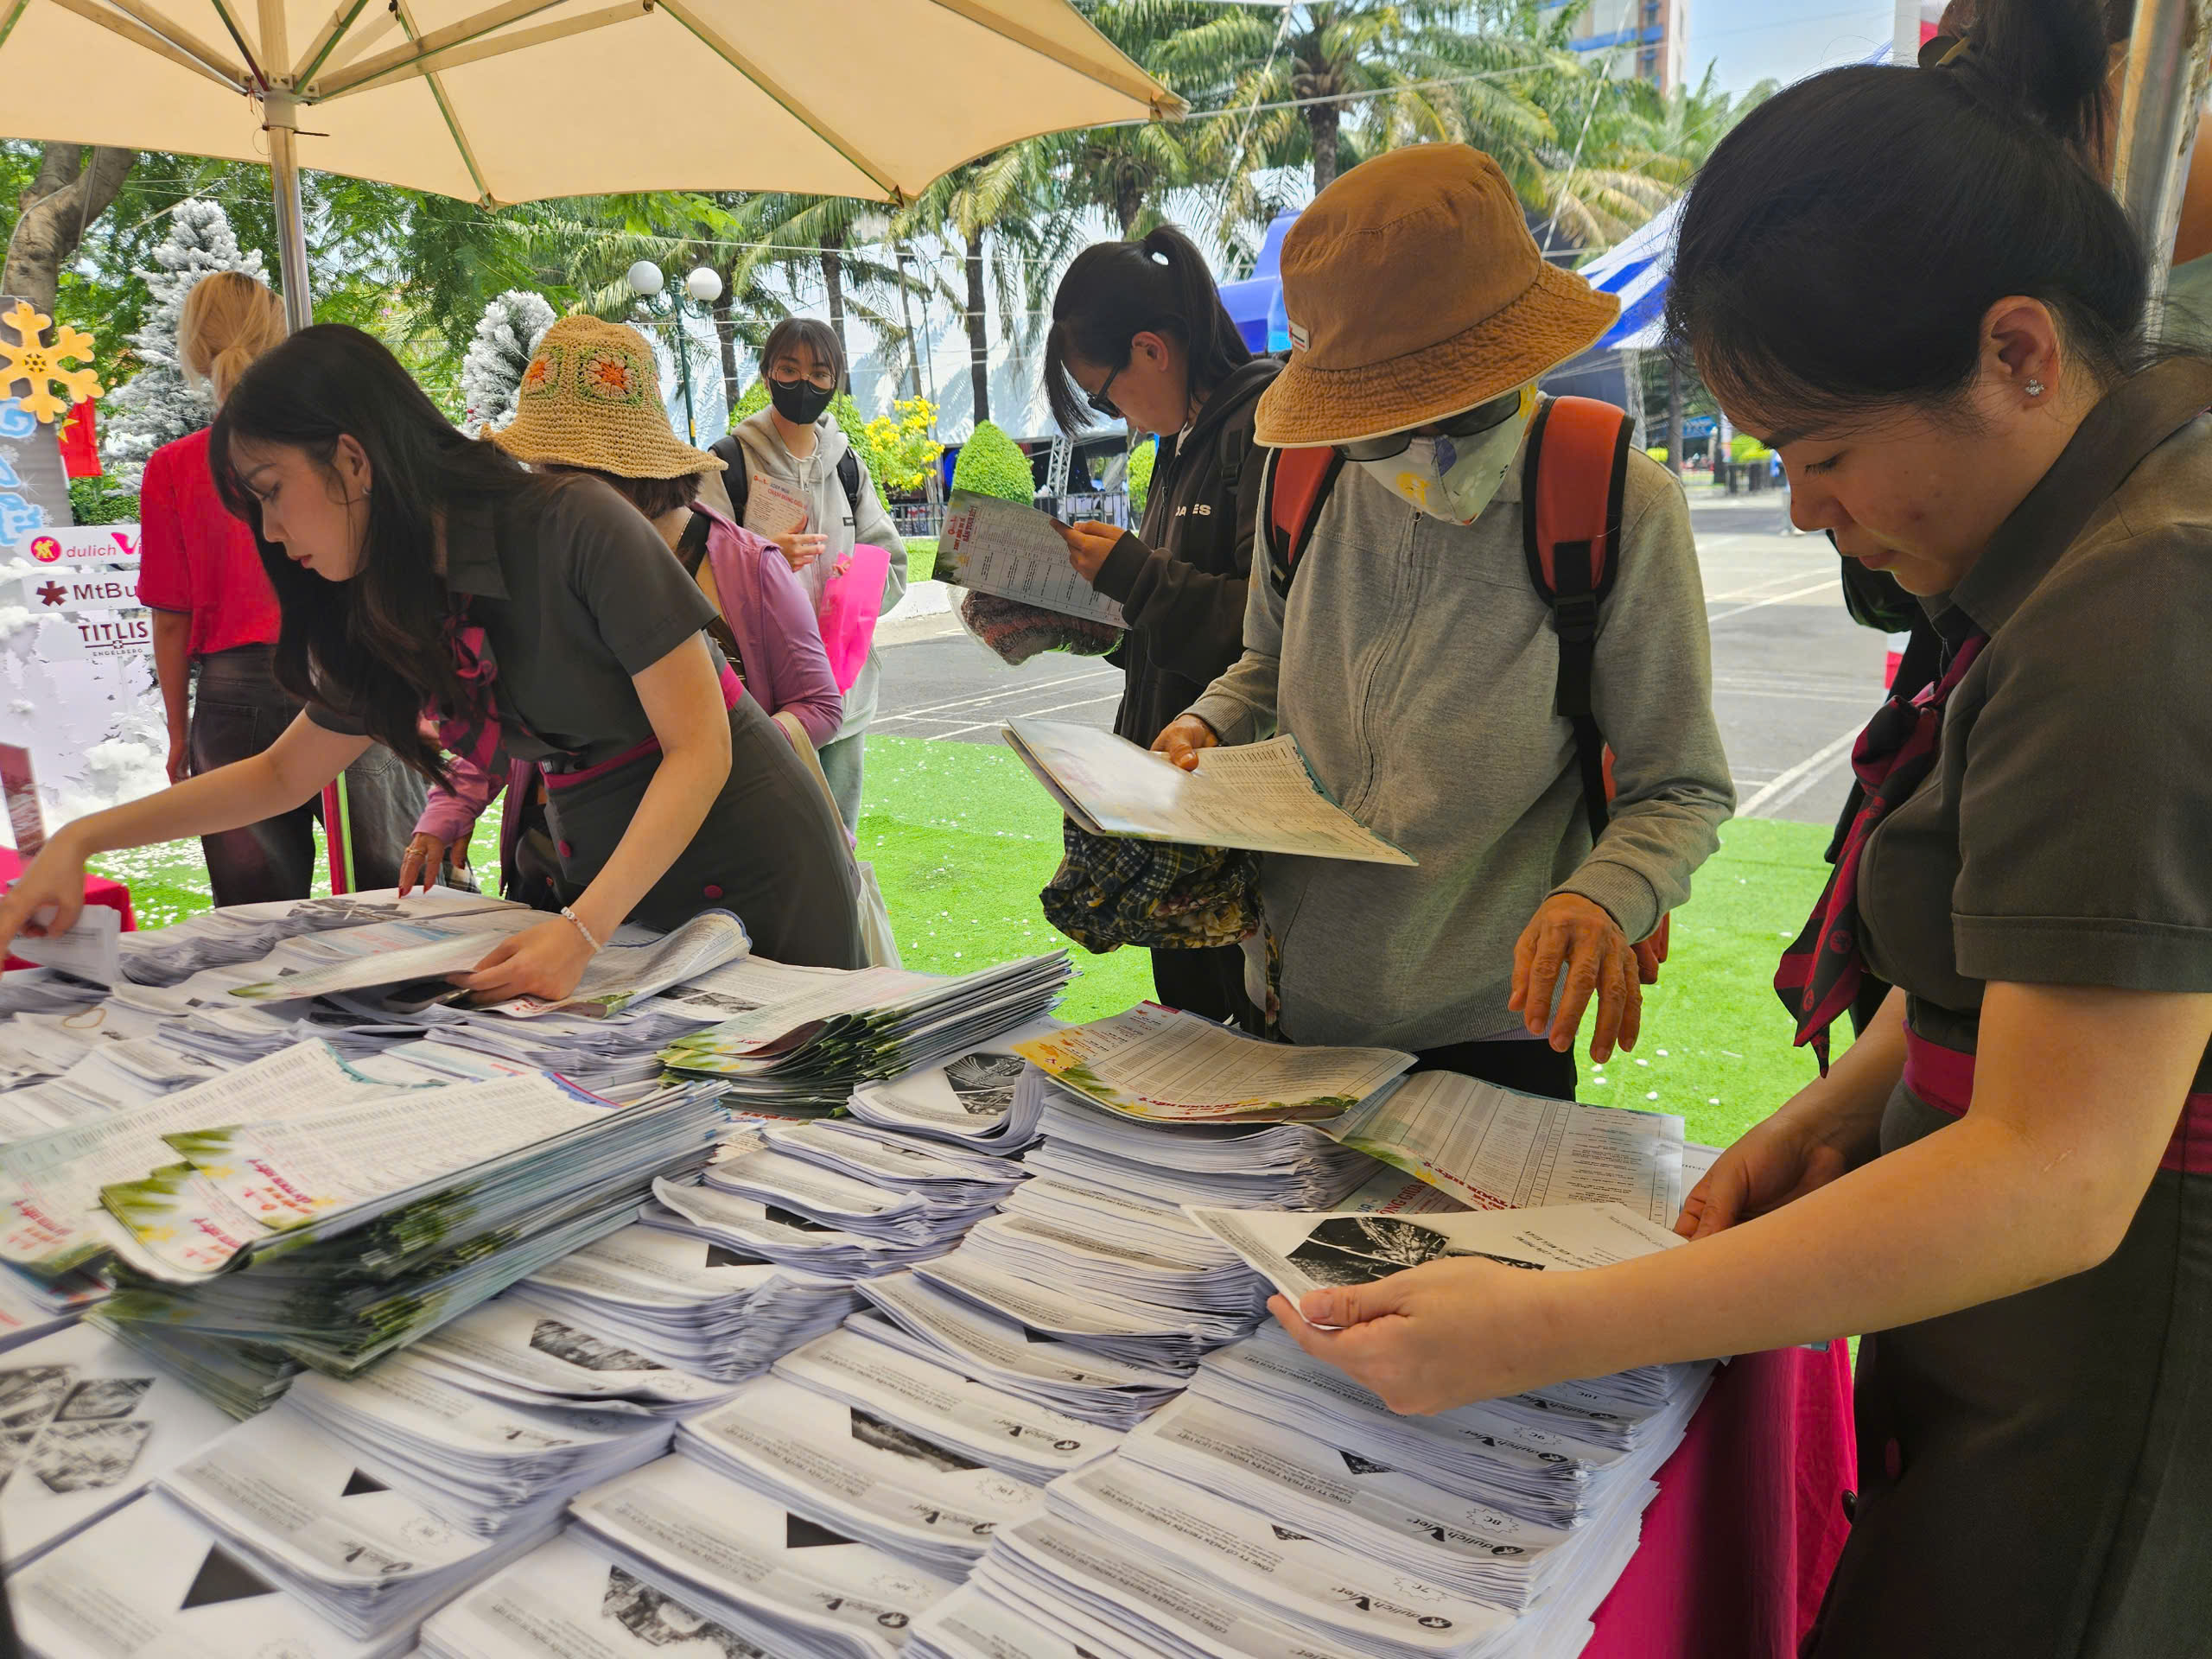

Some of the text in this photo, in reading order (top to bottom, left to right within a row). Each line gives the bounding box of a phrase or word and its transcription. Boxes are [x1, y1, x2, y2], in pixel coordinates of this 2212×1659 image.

[67, 532, 142, 558] dulichVi
[73, 582, 137, 601] MtBu
[78, 621, 149, 642] TITLIS
[1483, 1515, 1502, 1526] 8C
